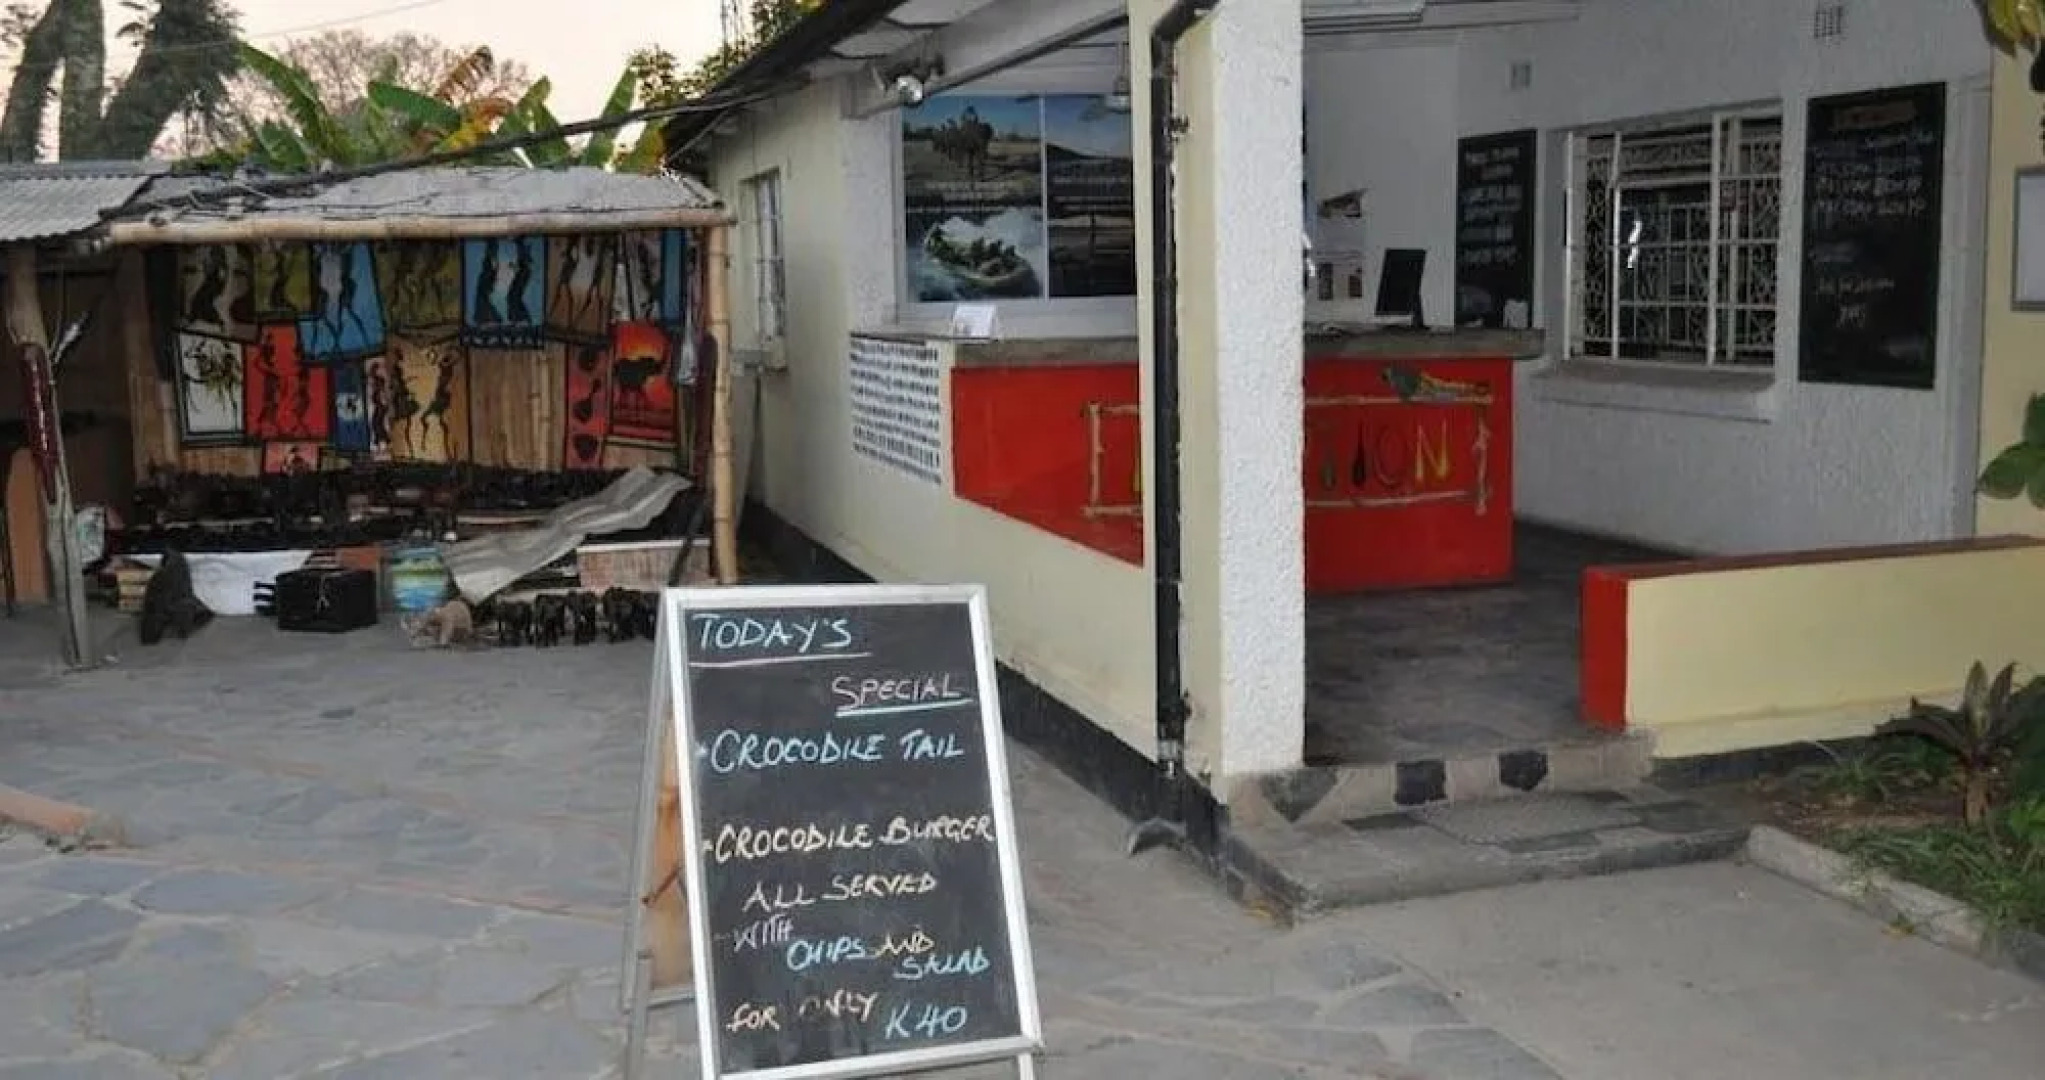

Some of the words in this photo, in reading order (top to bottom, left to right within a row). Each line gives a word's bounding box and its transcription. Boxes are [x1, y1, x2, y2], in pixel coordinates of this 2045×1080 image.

[691, 612, 852, 653] TODAY'S
[831, 674, 963, 712] SPECIAL
[711, 729, 886, 774] CROCODILE
[900, 729, 965, 762] TAIL
[715, 822, 874, 863] CROCODILE
[878, 814, 996, 845] BURGER
[742, 882, 816, 913] ALL
[821, 871, 939, 901] SERVED
[732, 912, 795, 953] WITH
[786, 935, 868, 971] CHIPS
[874, 927, 936, 957] AND
